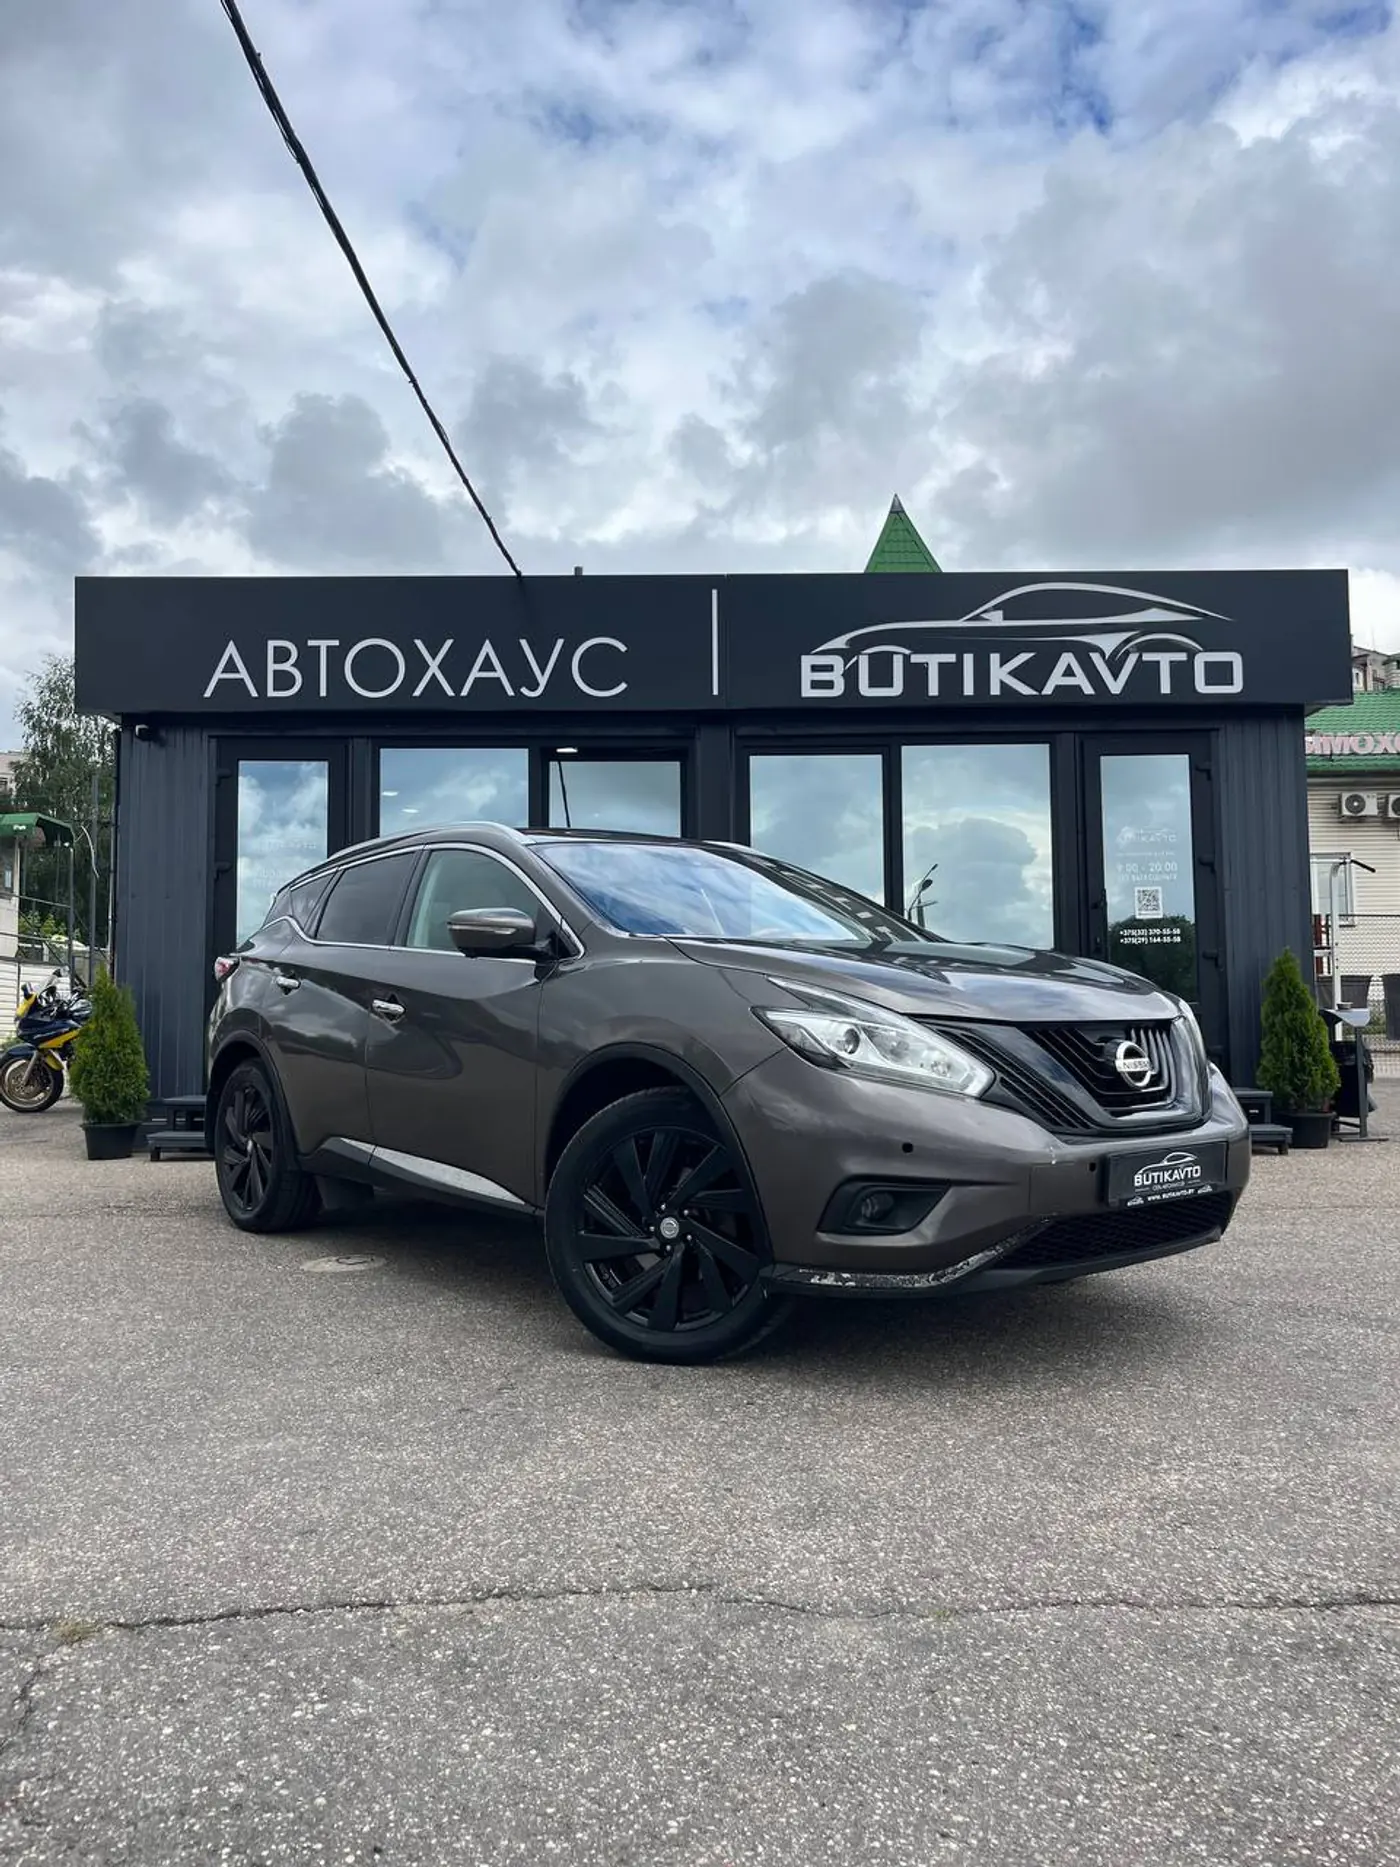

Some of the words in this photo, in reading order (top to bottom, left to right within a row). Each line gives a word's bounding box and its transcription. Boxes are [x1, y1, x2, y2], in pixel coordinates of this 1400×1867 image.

[203, 637, 628, 698] АВТОХАУС
[800, 651, 1243, 697] BUTIKAVTO
[1134, 1165, 1201, 1187] BUTIKAVTO
